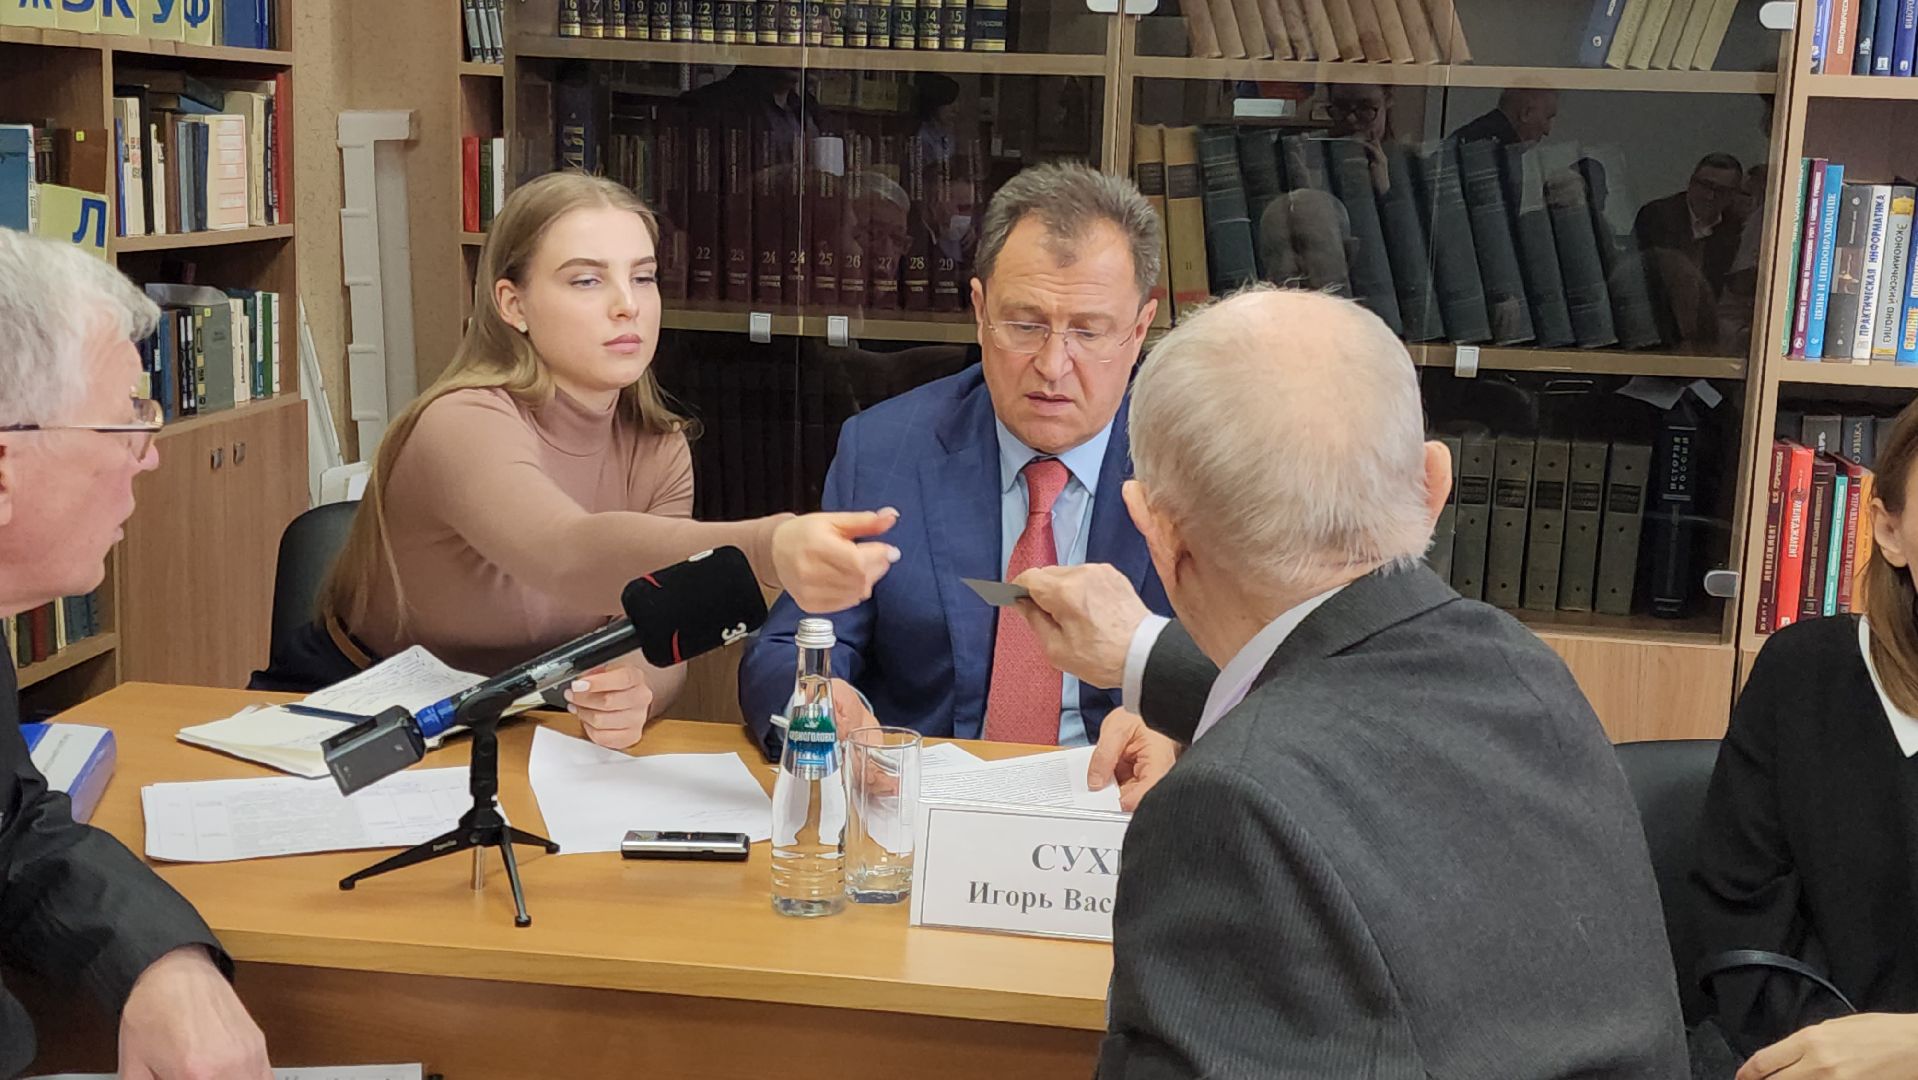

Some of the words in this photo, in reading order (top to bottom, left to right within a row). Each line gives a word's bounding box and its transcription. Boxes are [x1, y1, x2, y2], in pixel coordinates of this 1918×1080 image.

[72, 198, 107, 248] Л
[696, 248, 710, 260] 22
[909, 257, 925, 270] 28
[1814, 293, 1825, 321] ЦЕНЫ
[1820, 193, 1837, 282] ЦЕНООБРАЗОВАНИЕ
[1859, 268, 1877, 337] ПРАКТИЧЕСКАЯ
[1869, 194, 1886, 263] ИНФОРМАТИКА
[1888, 223, 1908, 305] Экономический
[1883, 305, 1895, 343] анализ
[1670, 436, 1680, 490] ИСТОРИЯ
[1679, 437, 1689, 490] РОССИИ
[1032, 843, 1121, 876] СУХ
[968, 880, 1053, 915] Игорь
[1064, 888, 1112, 914] Вас
